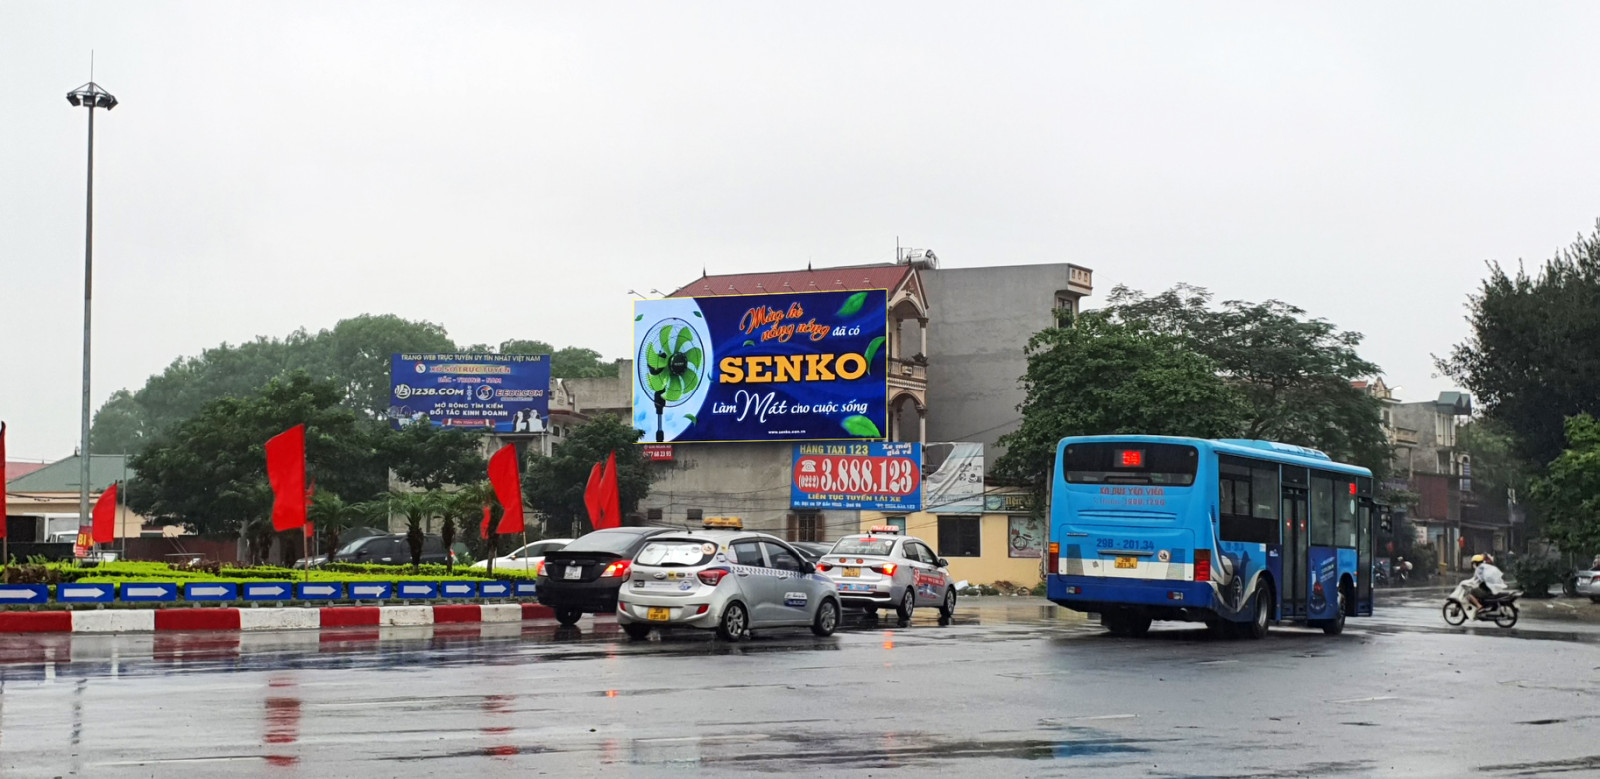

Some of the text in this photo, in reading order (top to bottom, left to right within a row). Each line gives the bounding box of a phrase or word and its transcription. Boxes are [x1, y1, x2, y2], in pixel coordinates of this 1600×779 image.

[740, 302, 804, 333] Mùa hè
[796, 318, 830, 342] nóng
[832, 326, 846, 336] đã
[848, 326, 860, 336] có
[719, 353, 867, 384] SENKO
[712, 390, 868, 423] Làm Mát cho cuộc sống
[827, 445, 846, 454] TAXI
[849, 445, 869, 455] 123
[798, 458, 912, 494] (0222) 3.888.123
[1096, 538, 1114, 548] 29B
[1123, 540, 1154, 550] 201.34
